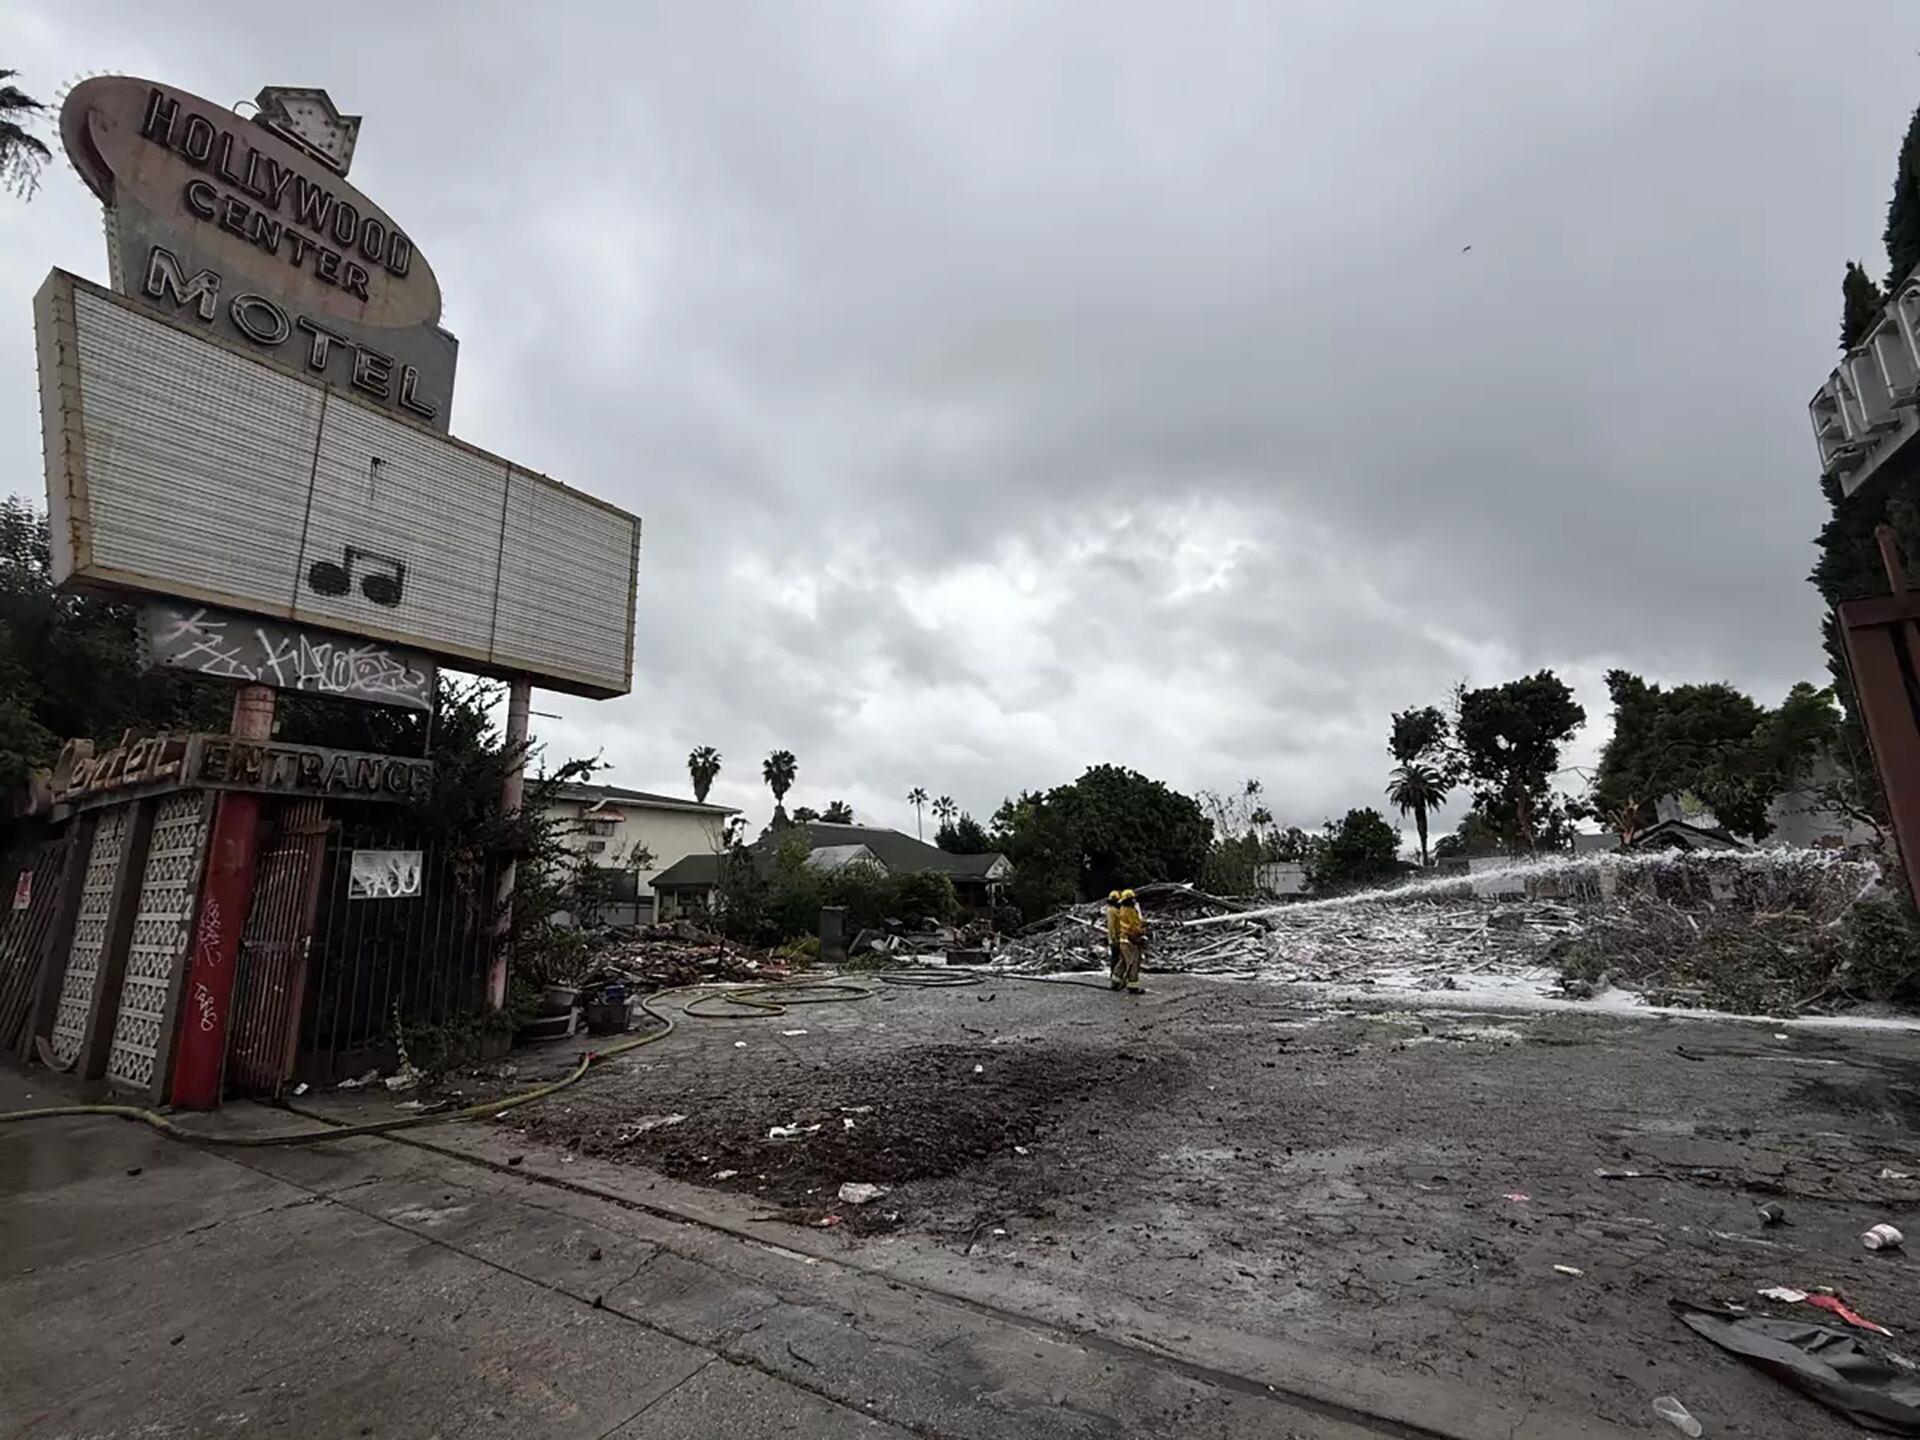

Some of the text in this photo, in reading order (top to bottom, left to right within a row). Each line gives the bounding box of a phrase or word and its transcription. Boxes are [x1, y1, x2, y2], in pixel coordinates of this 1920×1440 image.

[143, 87, 414, 279] HOLLYWOOD
[183, 178, 371, 302] CENTER
[142, 244, 437, 418] MOTEL
[202, 743, 434, 798] ENTRANCE
